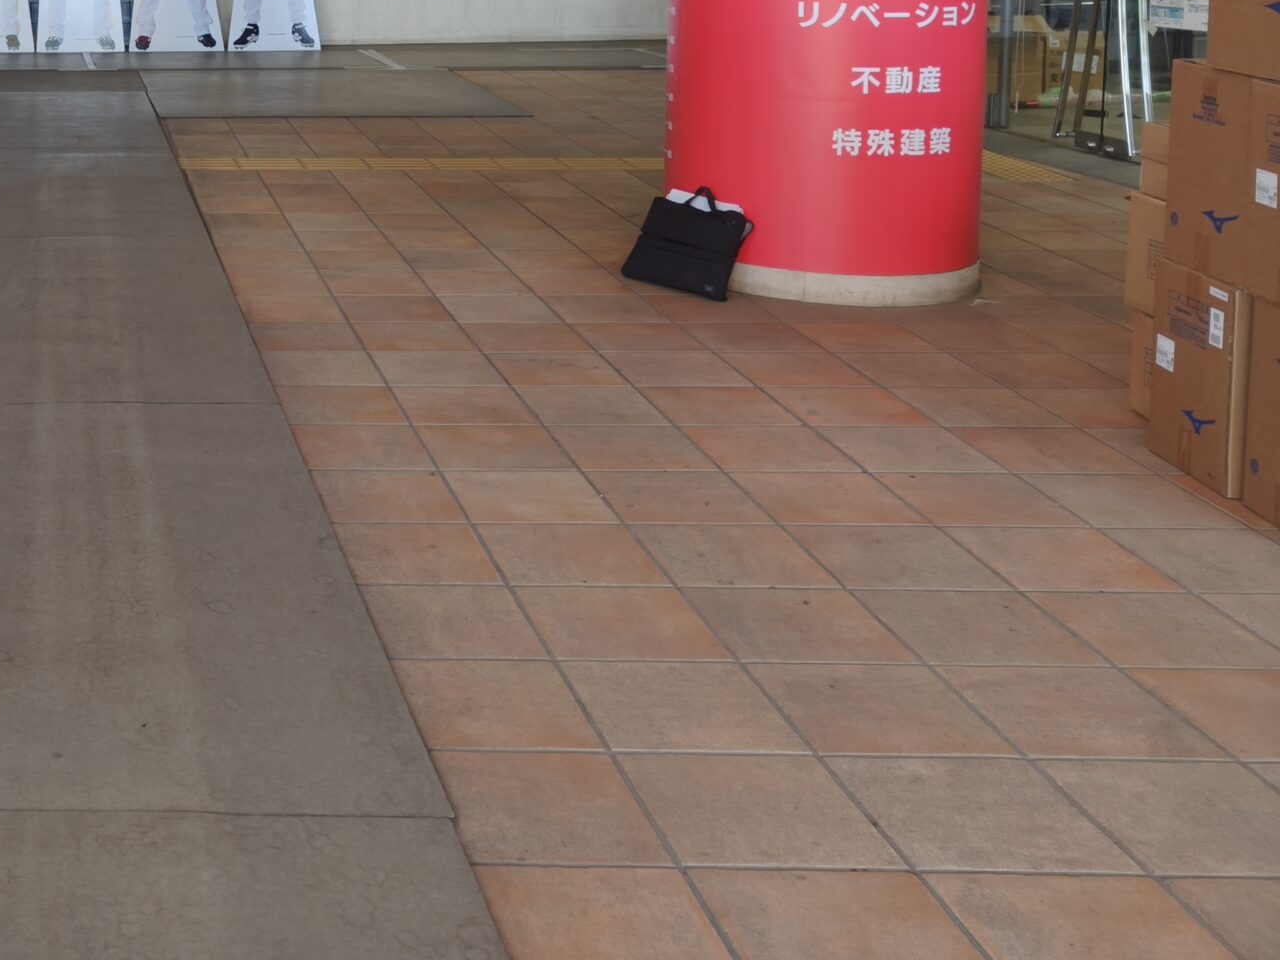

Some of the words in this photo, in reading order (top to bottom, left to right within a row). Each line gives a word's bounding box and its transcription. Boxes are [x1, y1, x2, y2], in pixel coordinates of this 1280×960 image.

[798, 1, 976, 28] リノベーション
[850, 66, 942, 95] 不動産
[832, 127, 952, 157] 特殊建築
